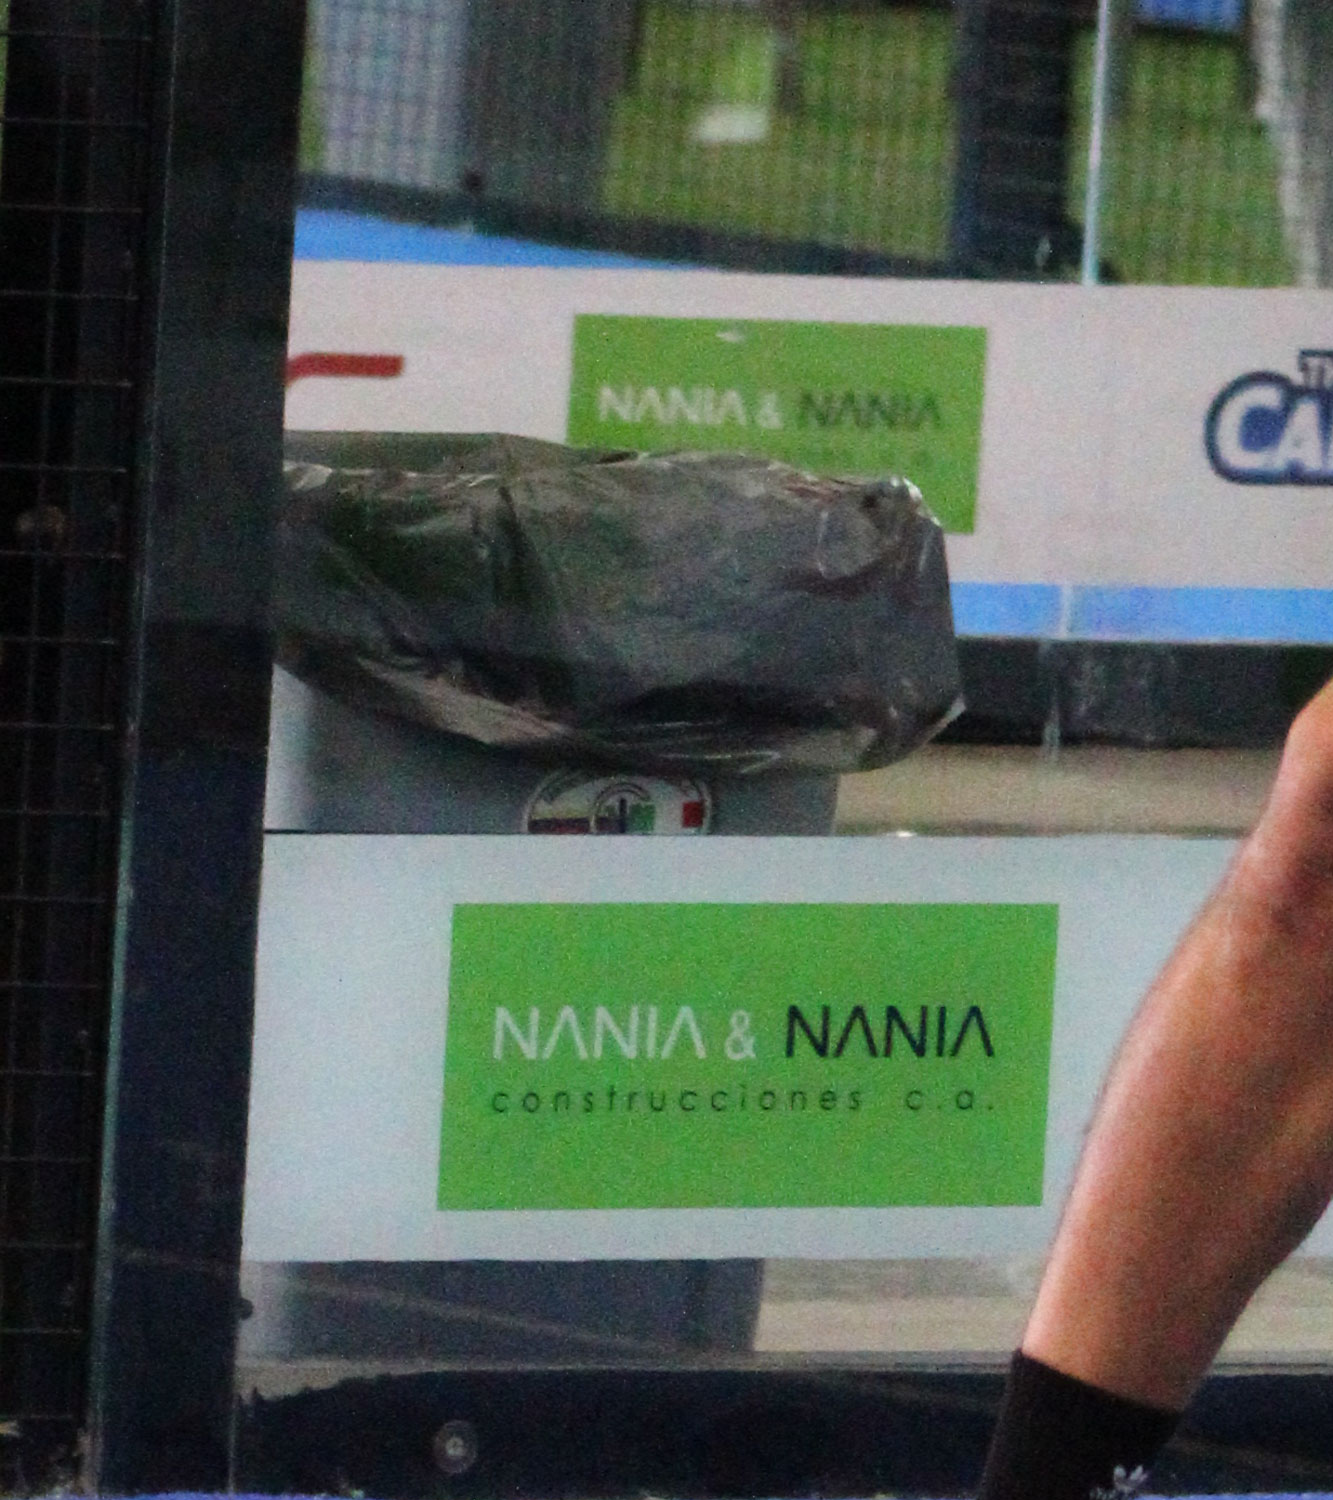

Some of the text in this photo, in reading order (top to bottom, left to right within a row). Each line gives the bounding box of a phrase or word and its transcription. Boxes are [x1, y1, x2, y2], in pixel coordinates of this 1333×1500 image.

[599, 385, 942, 430] NANIA & NANIA
[492, 1004, 995, 1062] NANIA & NANIA
[490, 1083, 995, 1114] construcciones c.a.
